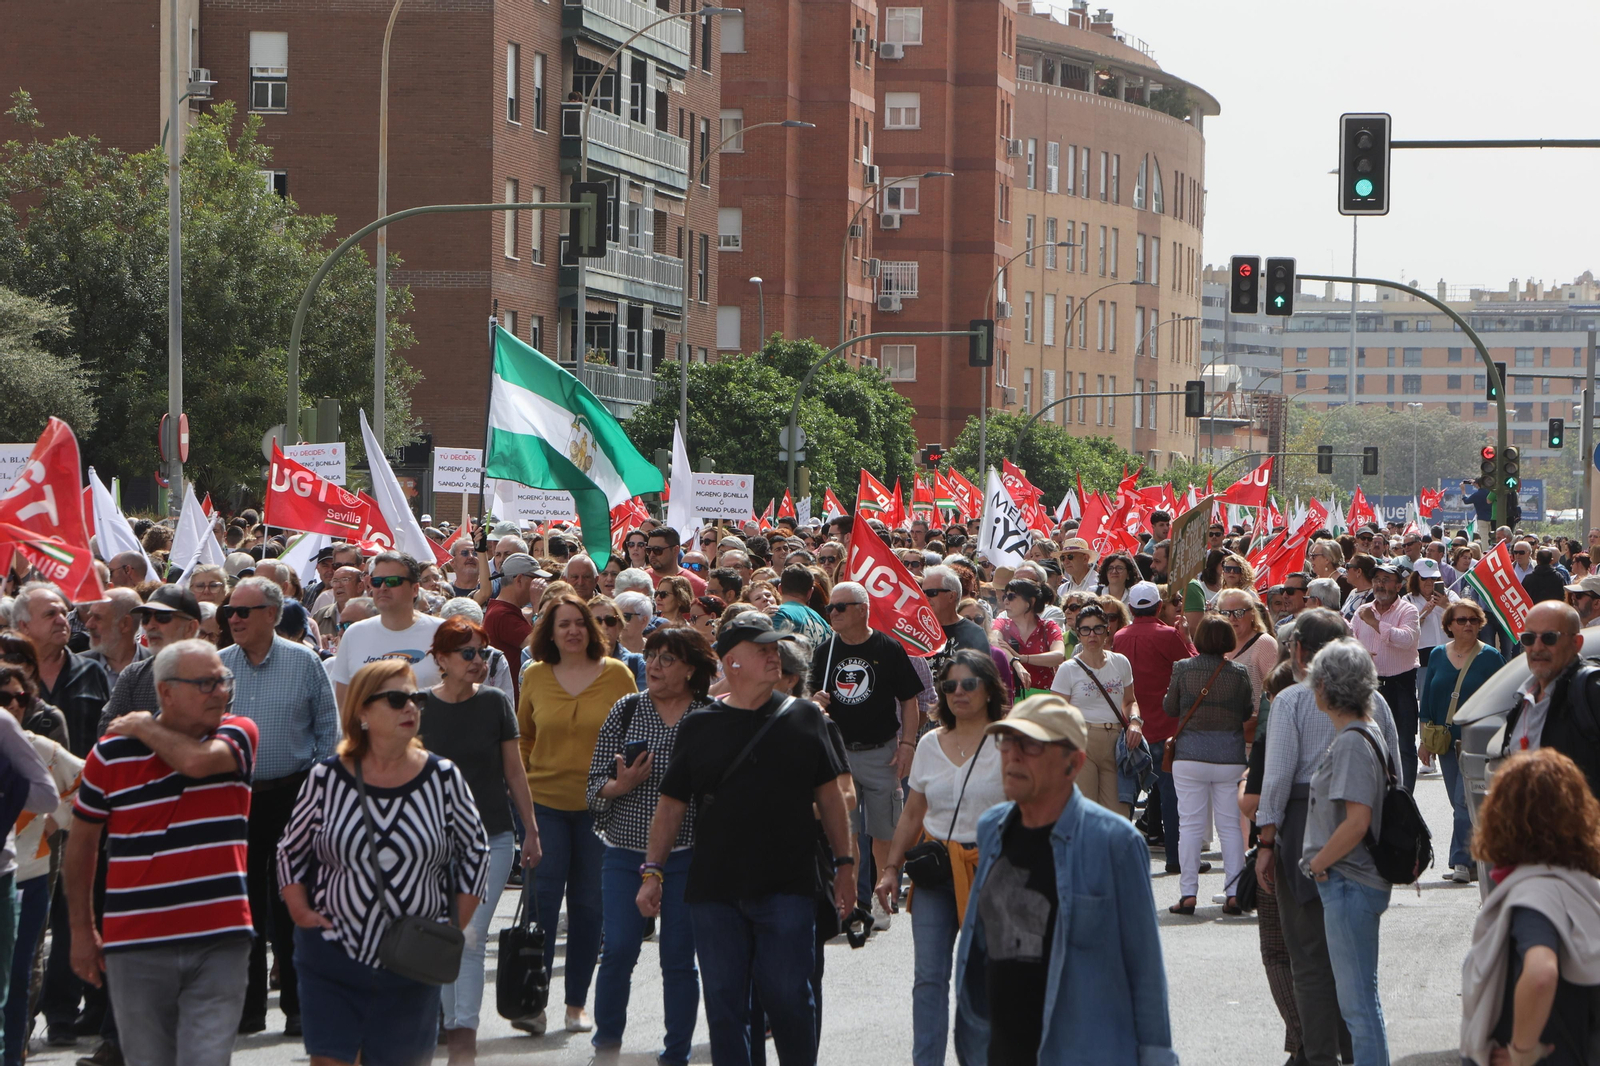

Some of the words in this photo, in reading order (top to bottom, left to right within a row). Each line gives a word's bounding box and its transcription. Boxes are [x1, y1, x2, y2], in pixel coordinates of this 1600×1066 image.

[271, 462, 328, 502] UGT
[327, 508, 361, 524] Sevilla
[850, 544, 920, 610] UGT
[1500, 594, 1522, 628] Sevilla
[895, 618, 933, 651] Sevilla
[848, 659, 869, 669] PAULI
[833, 688, 872, 704] ANTI-FASCIST
